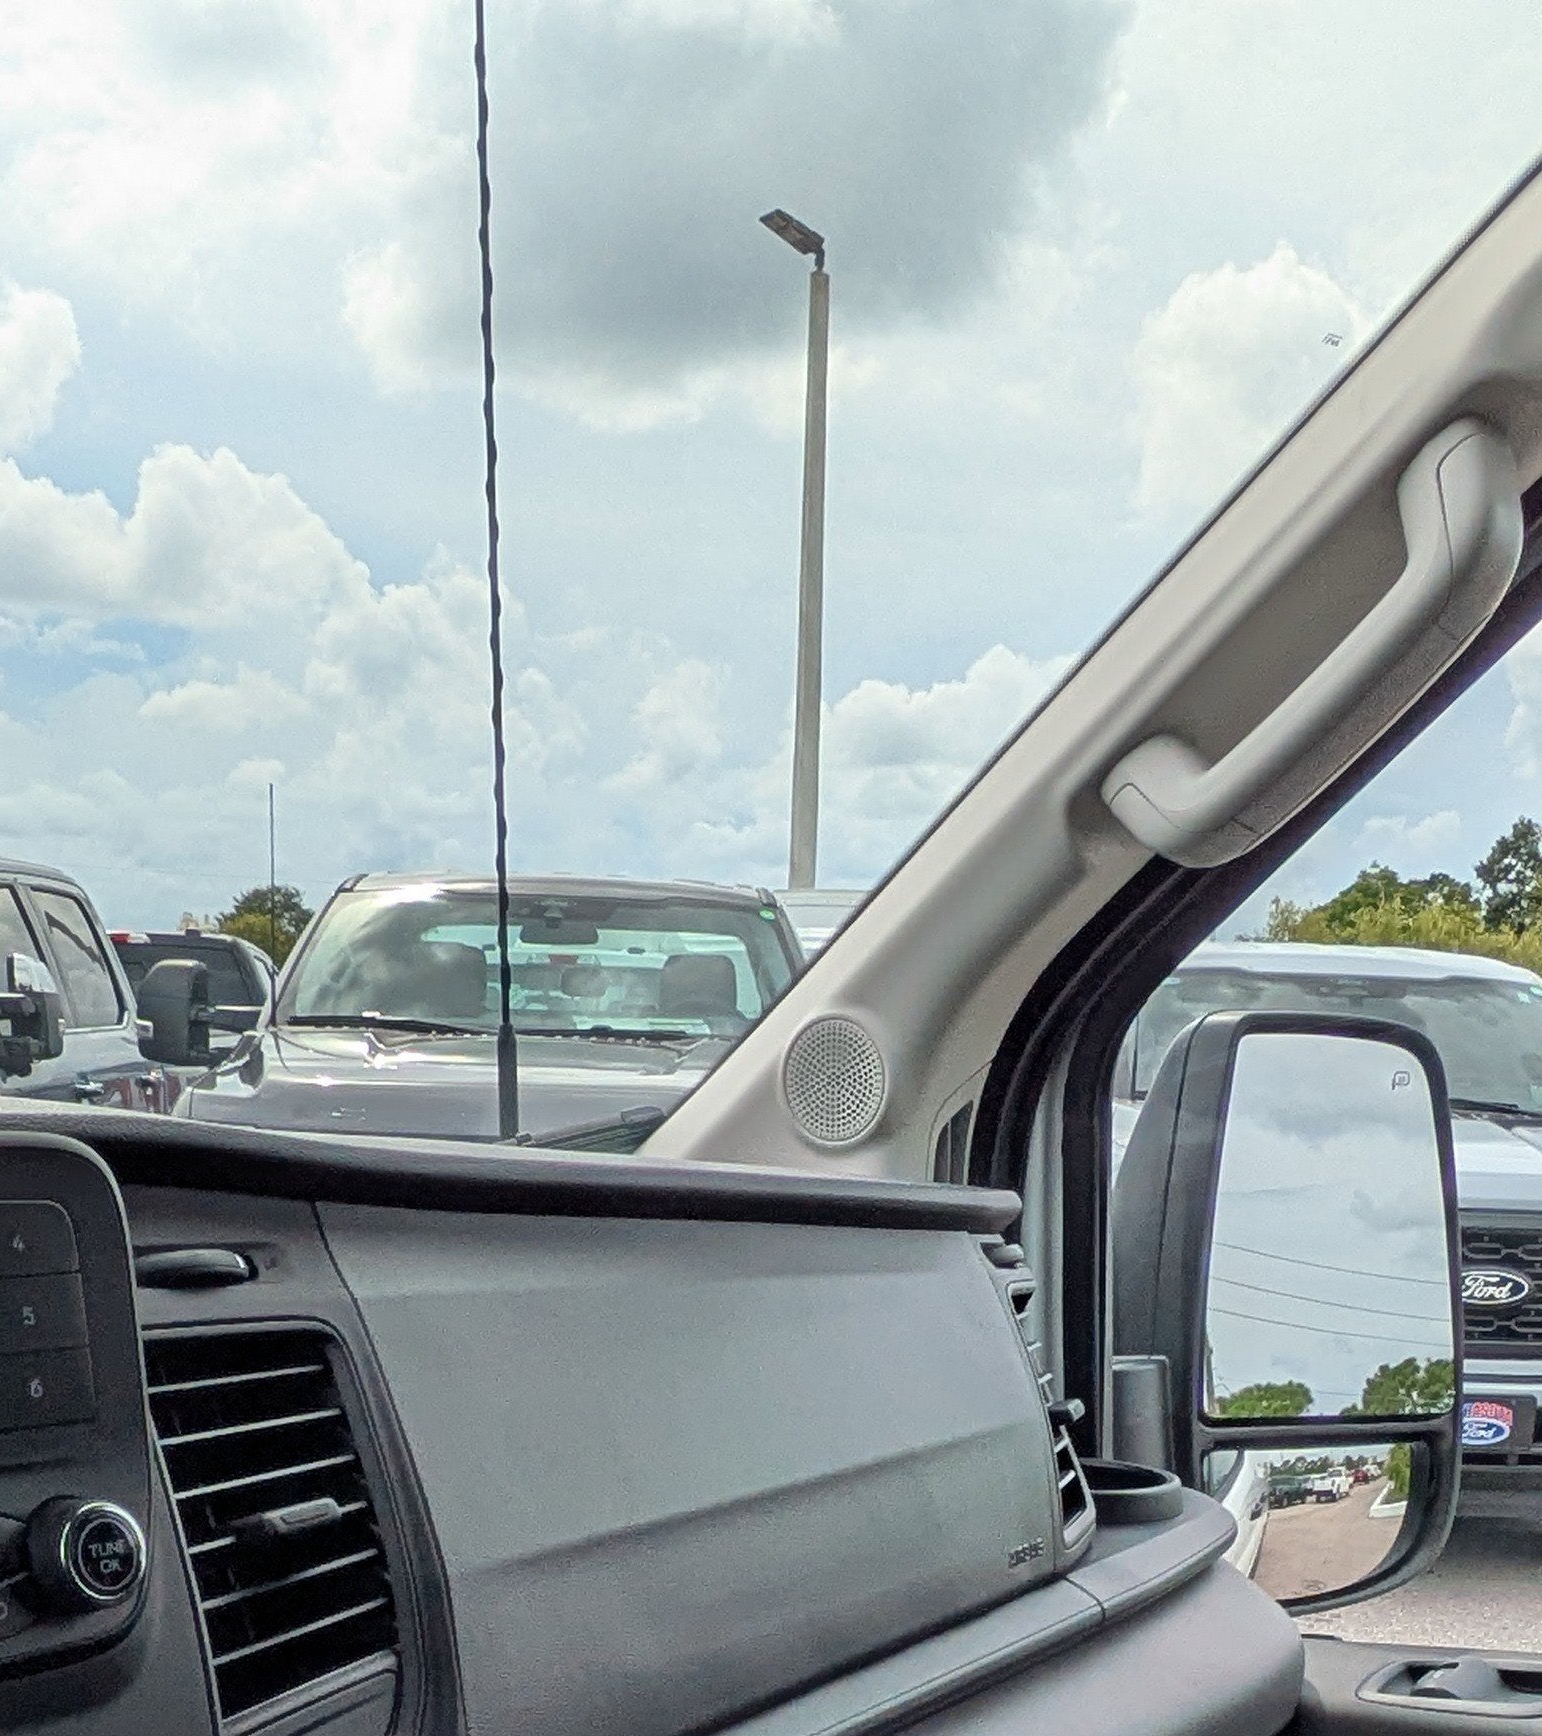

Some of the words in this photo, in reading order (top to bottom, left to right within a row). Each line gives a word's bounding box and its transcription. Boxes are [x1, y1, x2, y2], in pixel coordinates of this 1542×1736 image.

[1462, 1274, 1512, 1299] Ford
[22, 1306, 36, 1325] 5
[29, 1378, 43, 1398] 6
